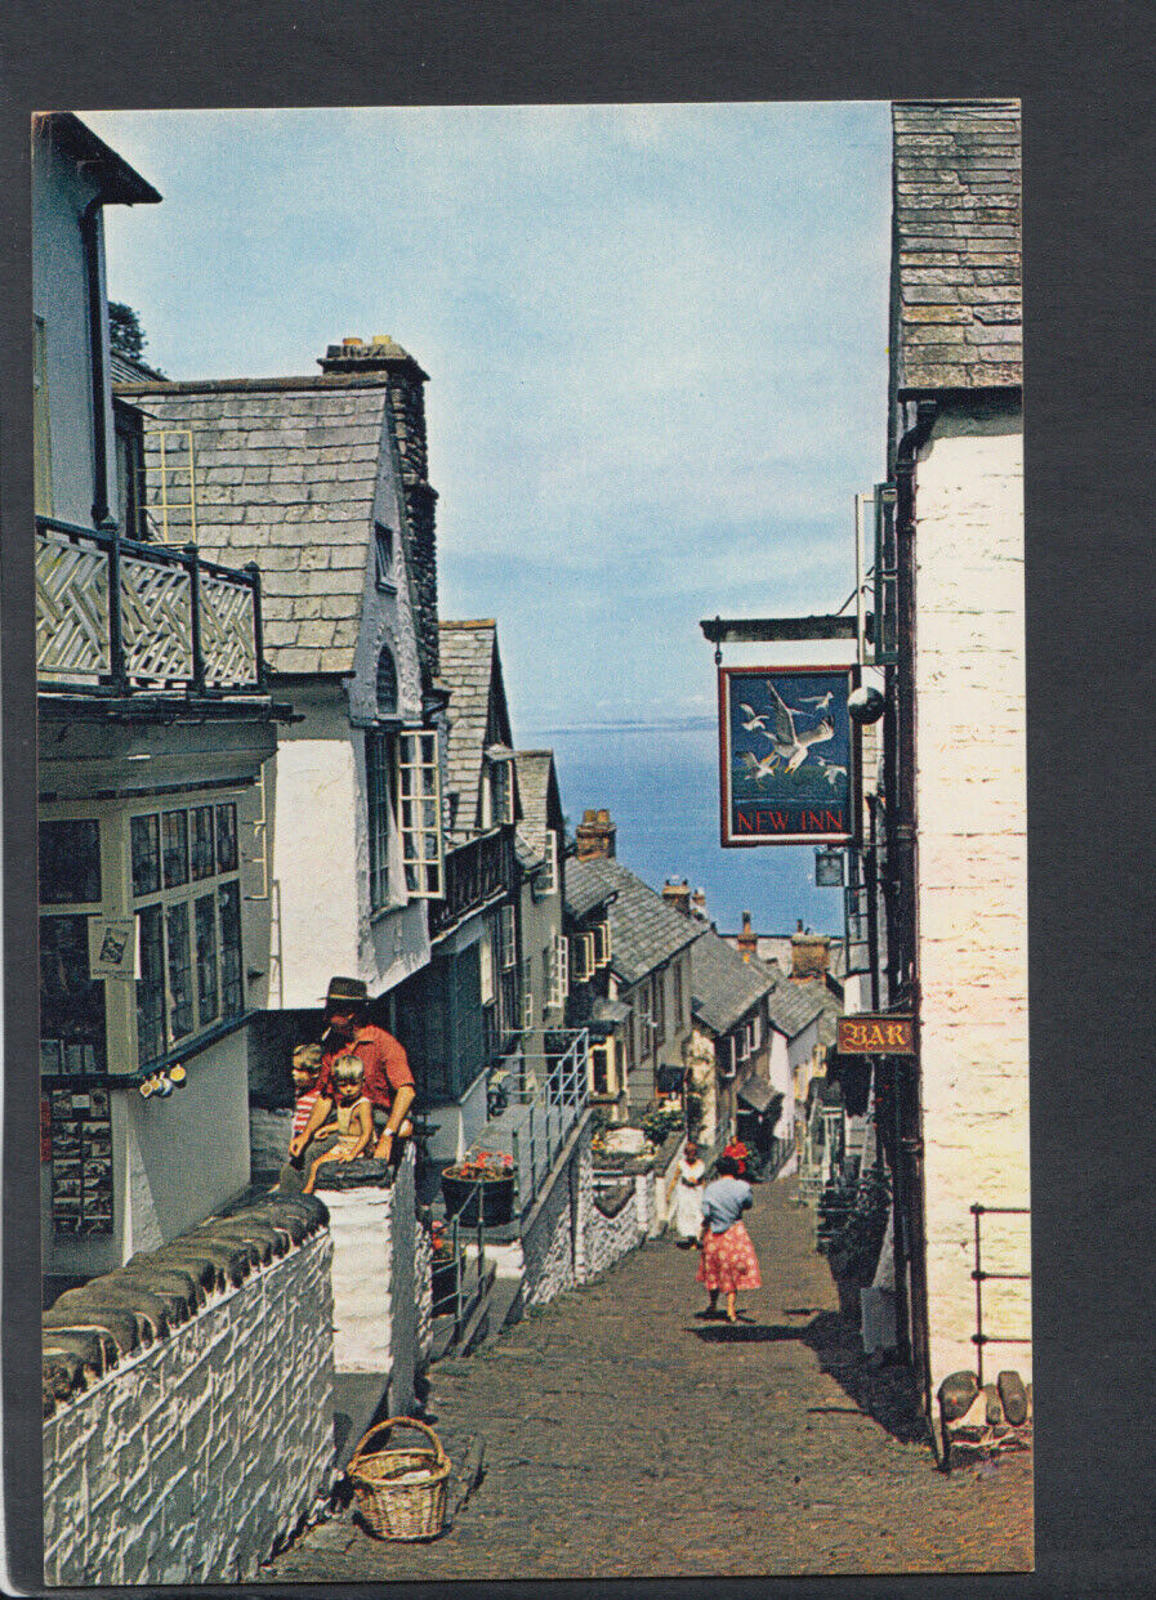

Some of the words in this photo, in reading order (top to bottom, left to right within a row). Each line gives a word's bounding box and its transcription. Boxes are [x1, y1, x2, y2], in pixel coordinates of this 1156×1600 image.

[738, 810, 789, 832] NEW
[802, 810, 842, 831] INN
[843, 1023, 905, 1049] BAR
